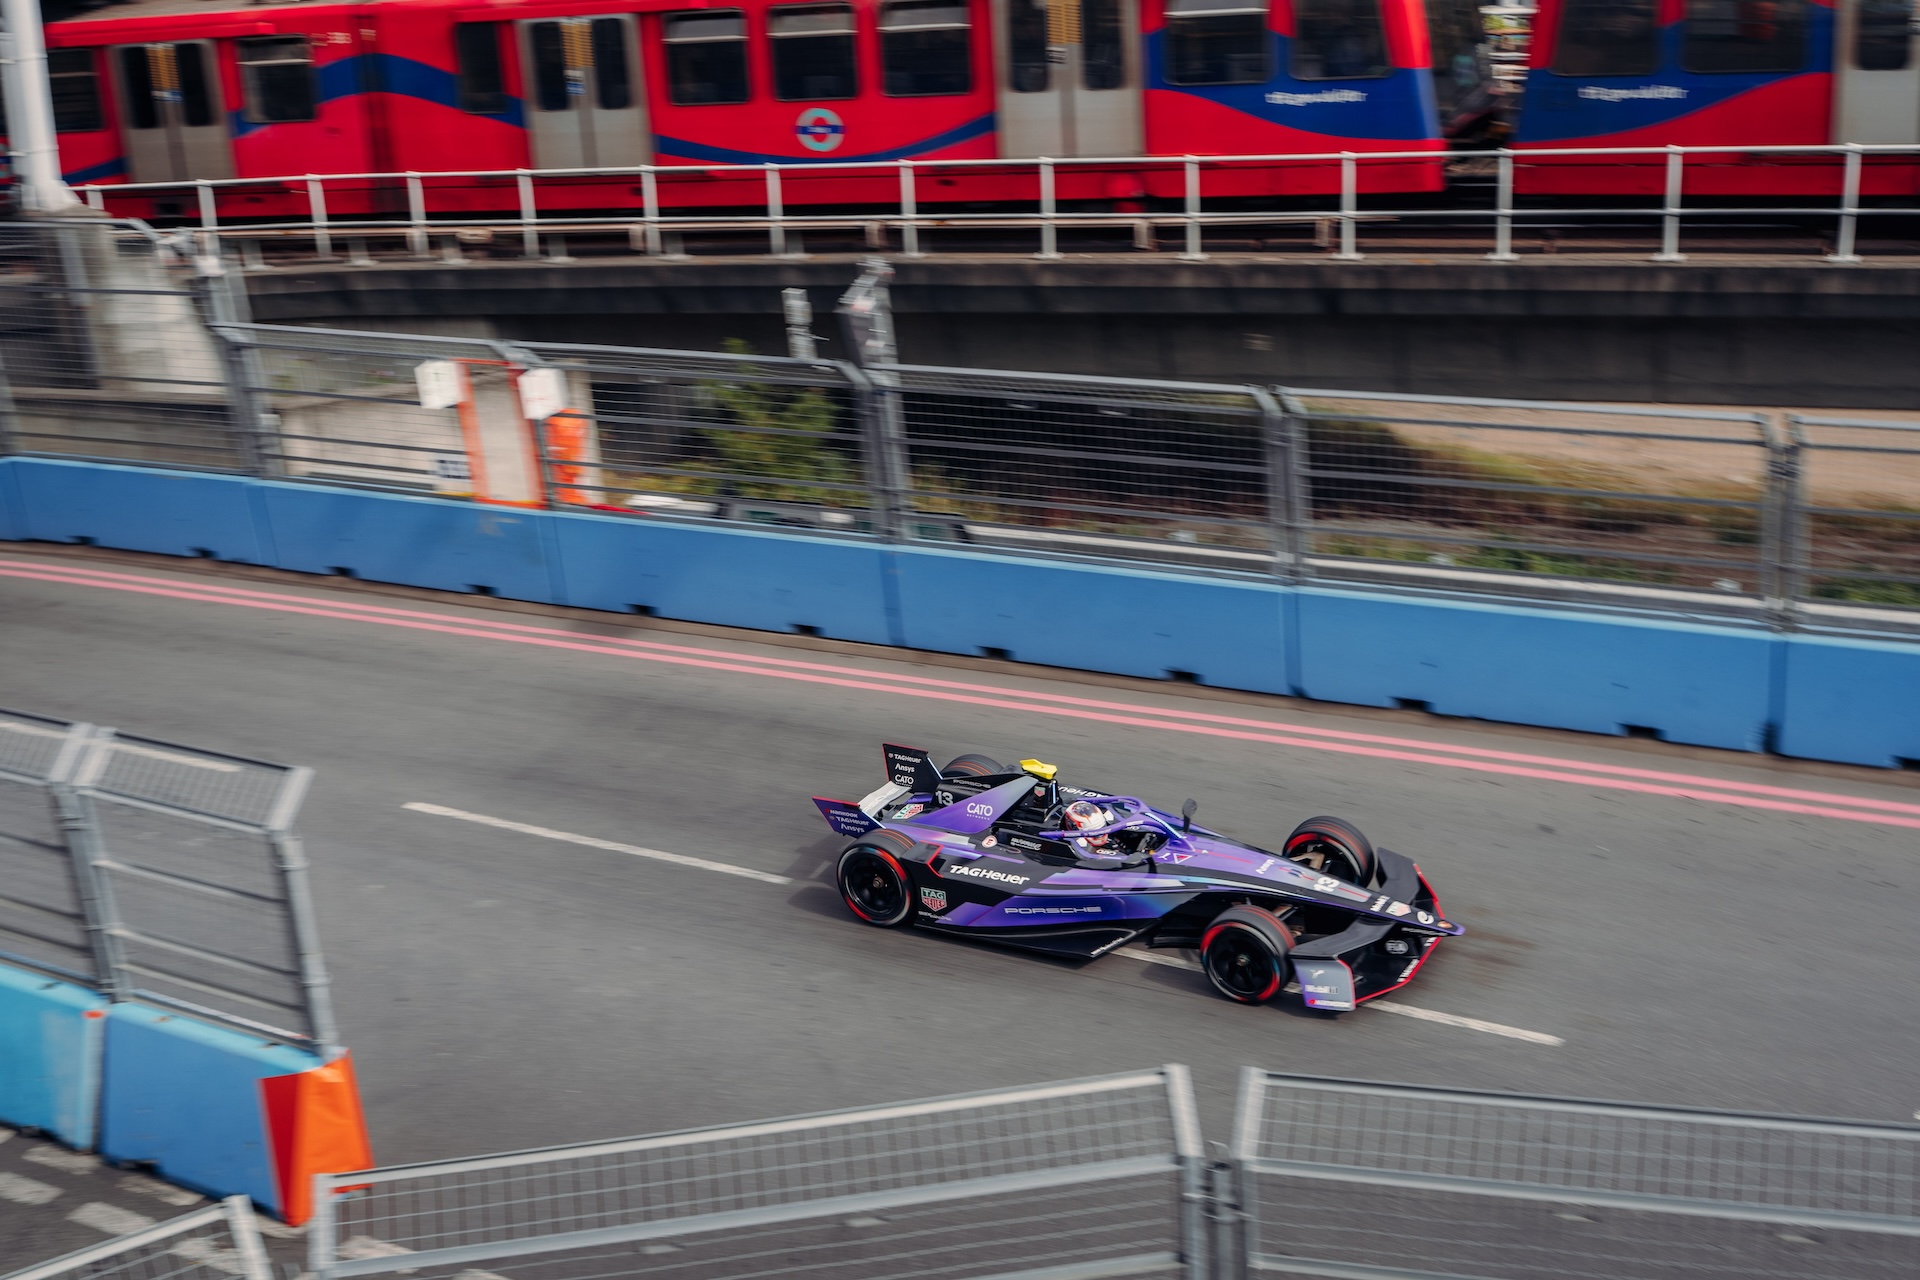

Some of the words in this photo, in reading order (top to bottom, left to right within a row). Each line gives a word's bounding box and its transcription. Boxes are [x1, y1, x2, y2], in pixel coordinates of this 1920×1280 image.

[894, 763, 915, 773] Ansys
[894, 774, 915, 785] CATO
[935, 790, 954, 807] 13
[966, 802, 994, 817] CATO
[840, 823, 866, 833] Ansys
[949, 864, 1031, 885] TAGHeuer
[923, 888, 945, 900] TAG
[922, 897, 946, 912] HEUER
[1003, 906, 1102, 915] PORSCHE
